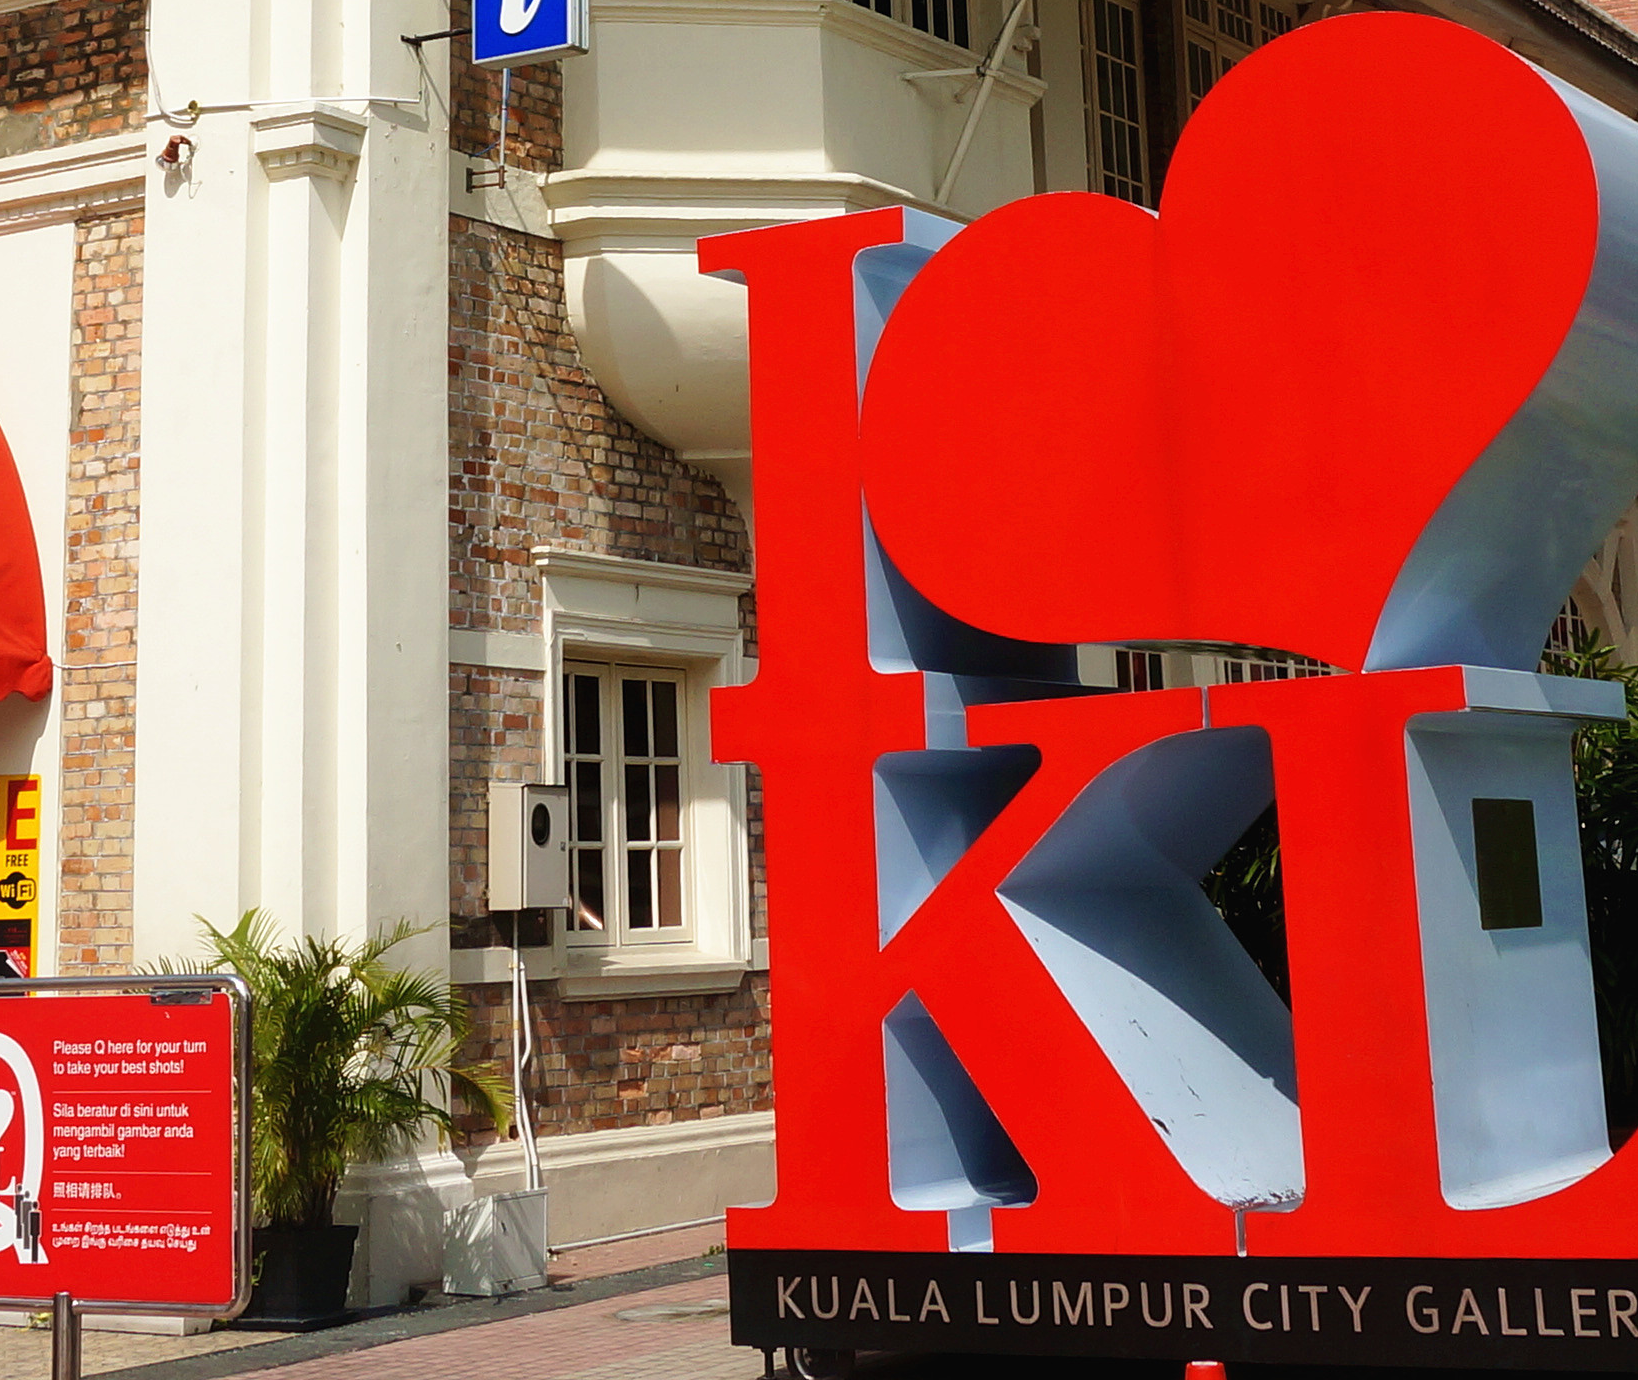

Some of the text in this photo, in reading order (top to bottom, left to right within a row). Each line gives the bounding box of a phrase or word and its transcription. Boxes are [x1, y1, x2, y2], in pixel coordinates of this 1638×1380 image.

[5, 853, 29, 868] FREE
[53, 1039, 207, 1057] Please Q here for your turn
[53, 1059, 185, 1078] to take your best shots!
[53, 1102, 189, 1118] Sila beratur di sini untuk
[53, 1123, 194, 1141] mengambil gambar anda
[53, 1144, 125, 1161] yang terbaik!
[53, 1181, 122, 1200] 照相请排队。
[776, 1275, 951, 1324] KUALA
[974, 1279, 1215, 1329] LUMPUR
[1242, 1282, 1373, 1333] CITY
